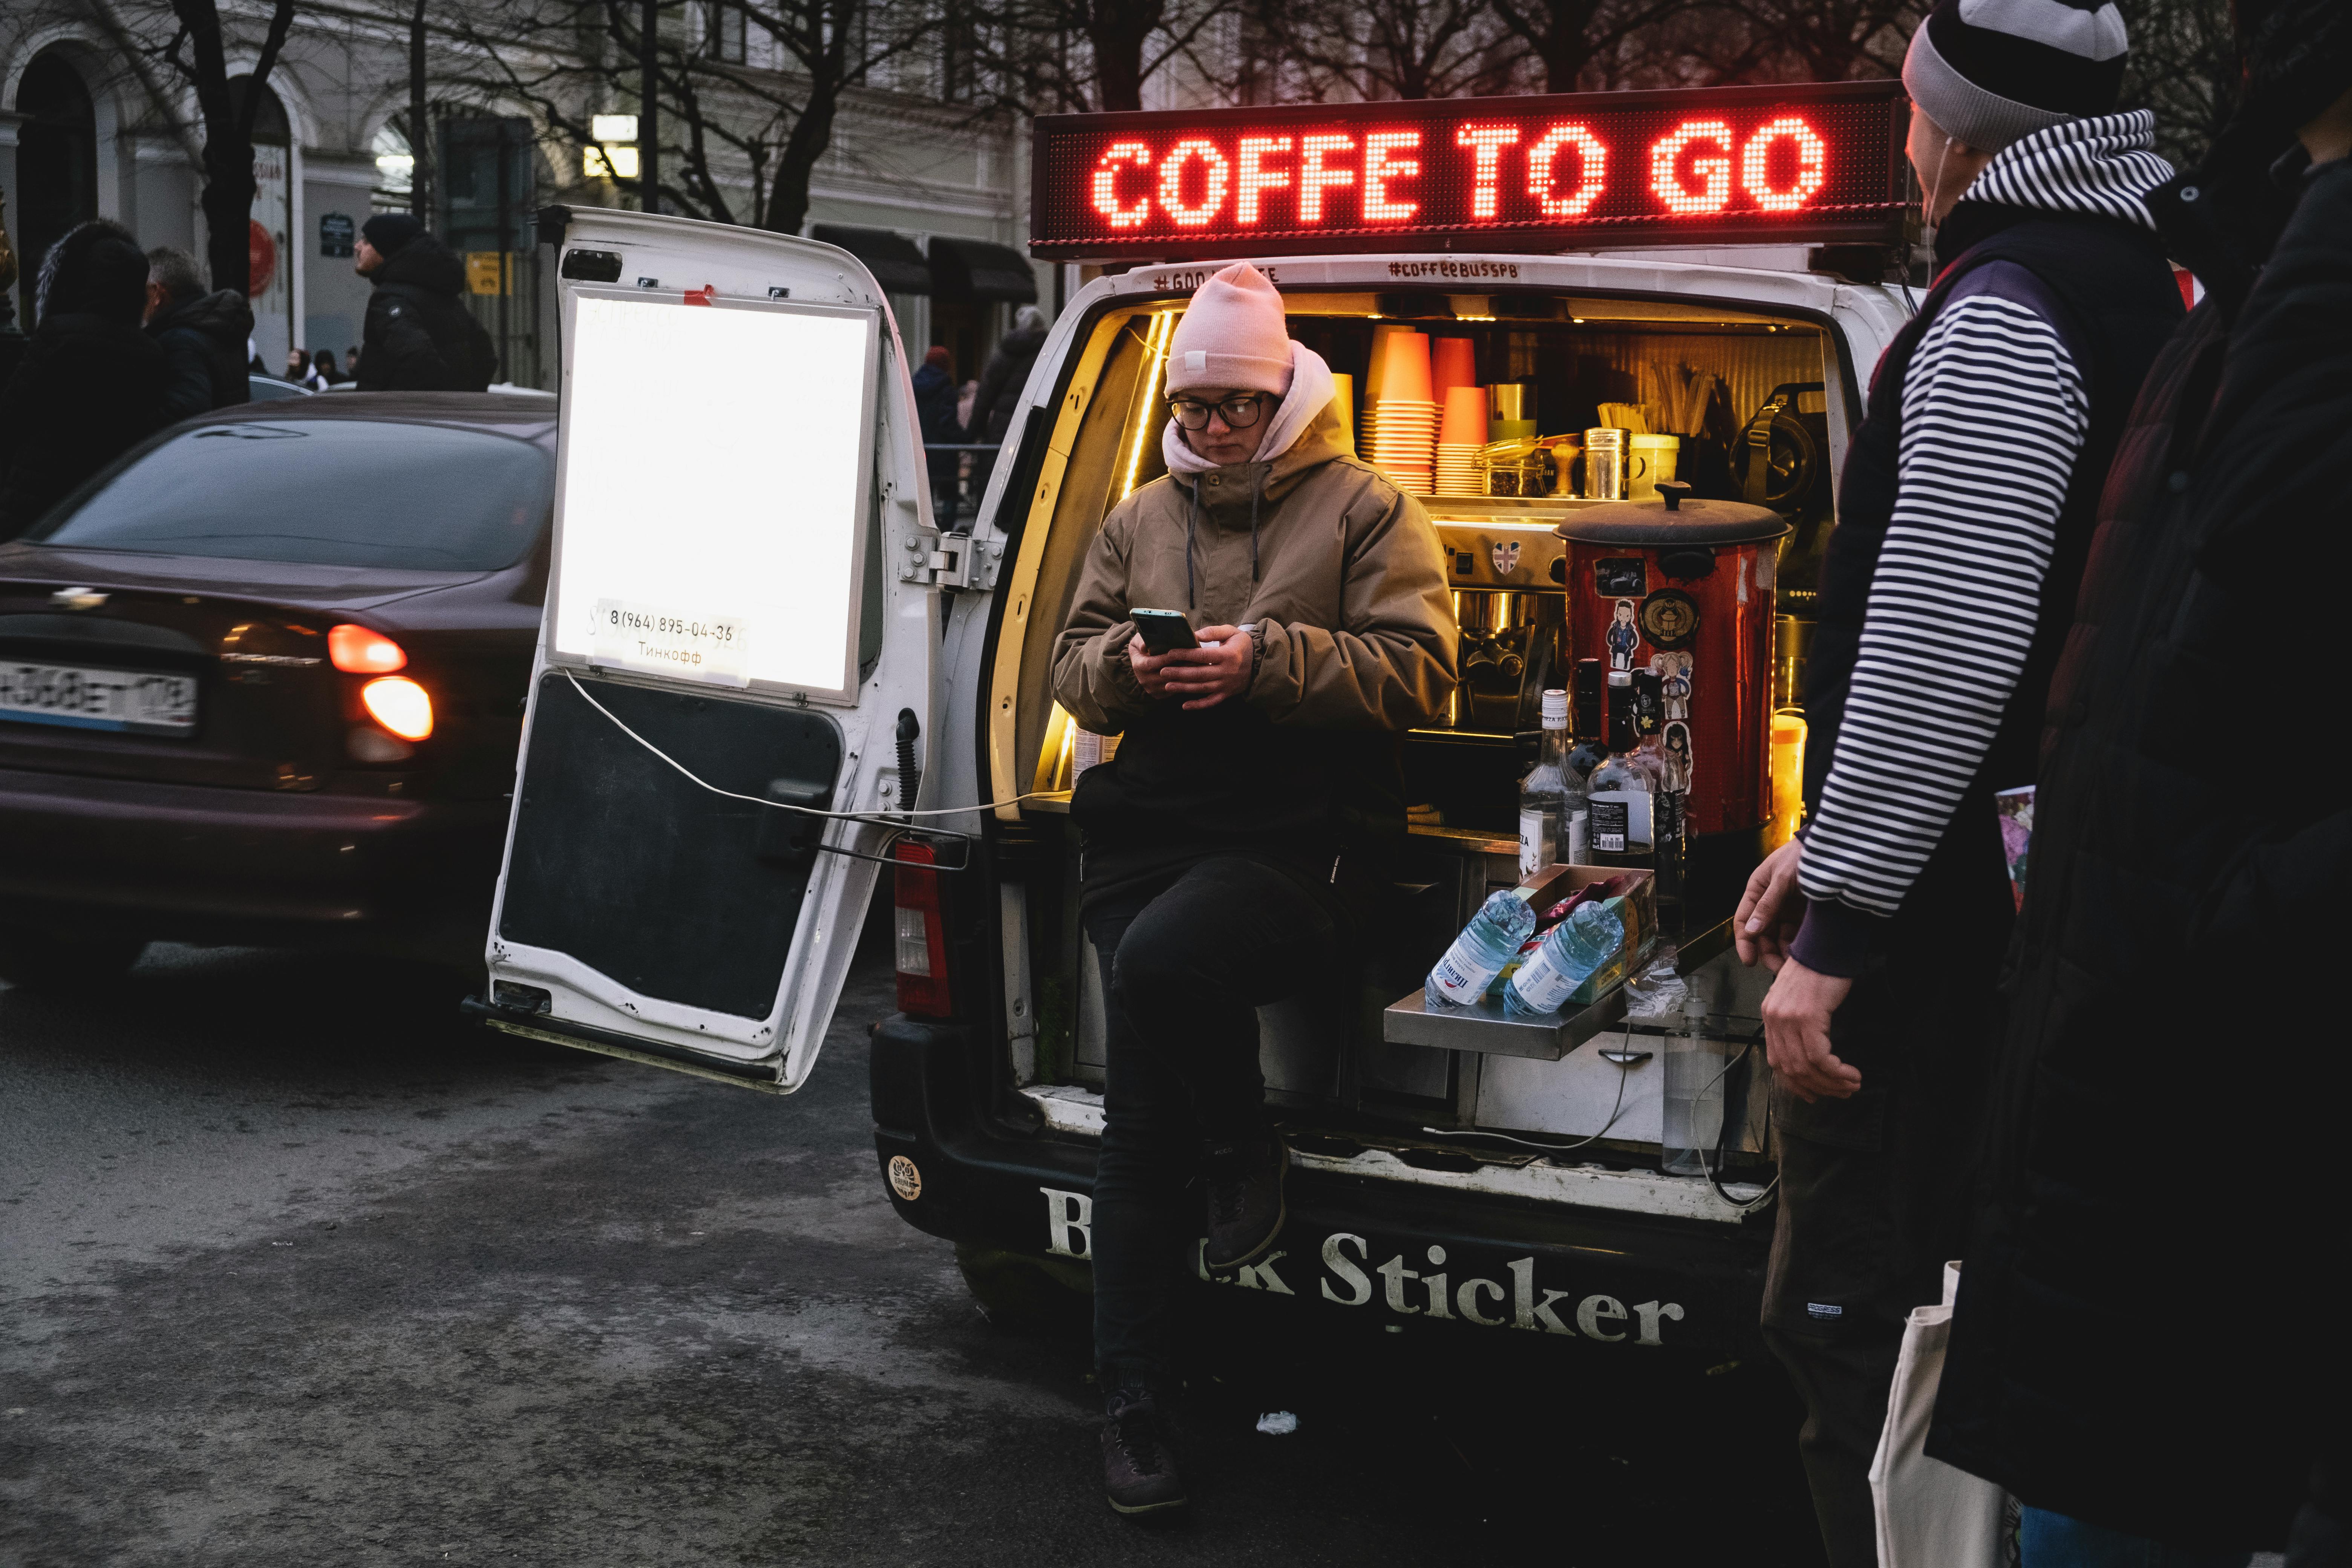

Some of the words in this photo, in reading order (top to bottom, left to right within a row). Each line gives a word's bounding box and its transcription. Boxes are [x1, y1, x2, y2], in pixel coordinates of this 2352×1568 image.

[1091, 130, 1421, 228] COFFE
[1456, 123, 1607, 217] TO
[1649, 117, 1825, 213] GO
[638, 641, 702, 666] Тинкофф
[659, 617, 732, 641] 895-04-36
[1321, 1232, 1685, 1347] Sticker
